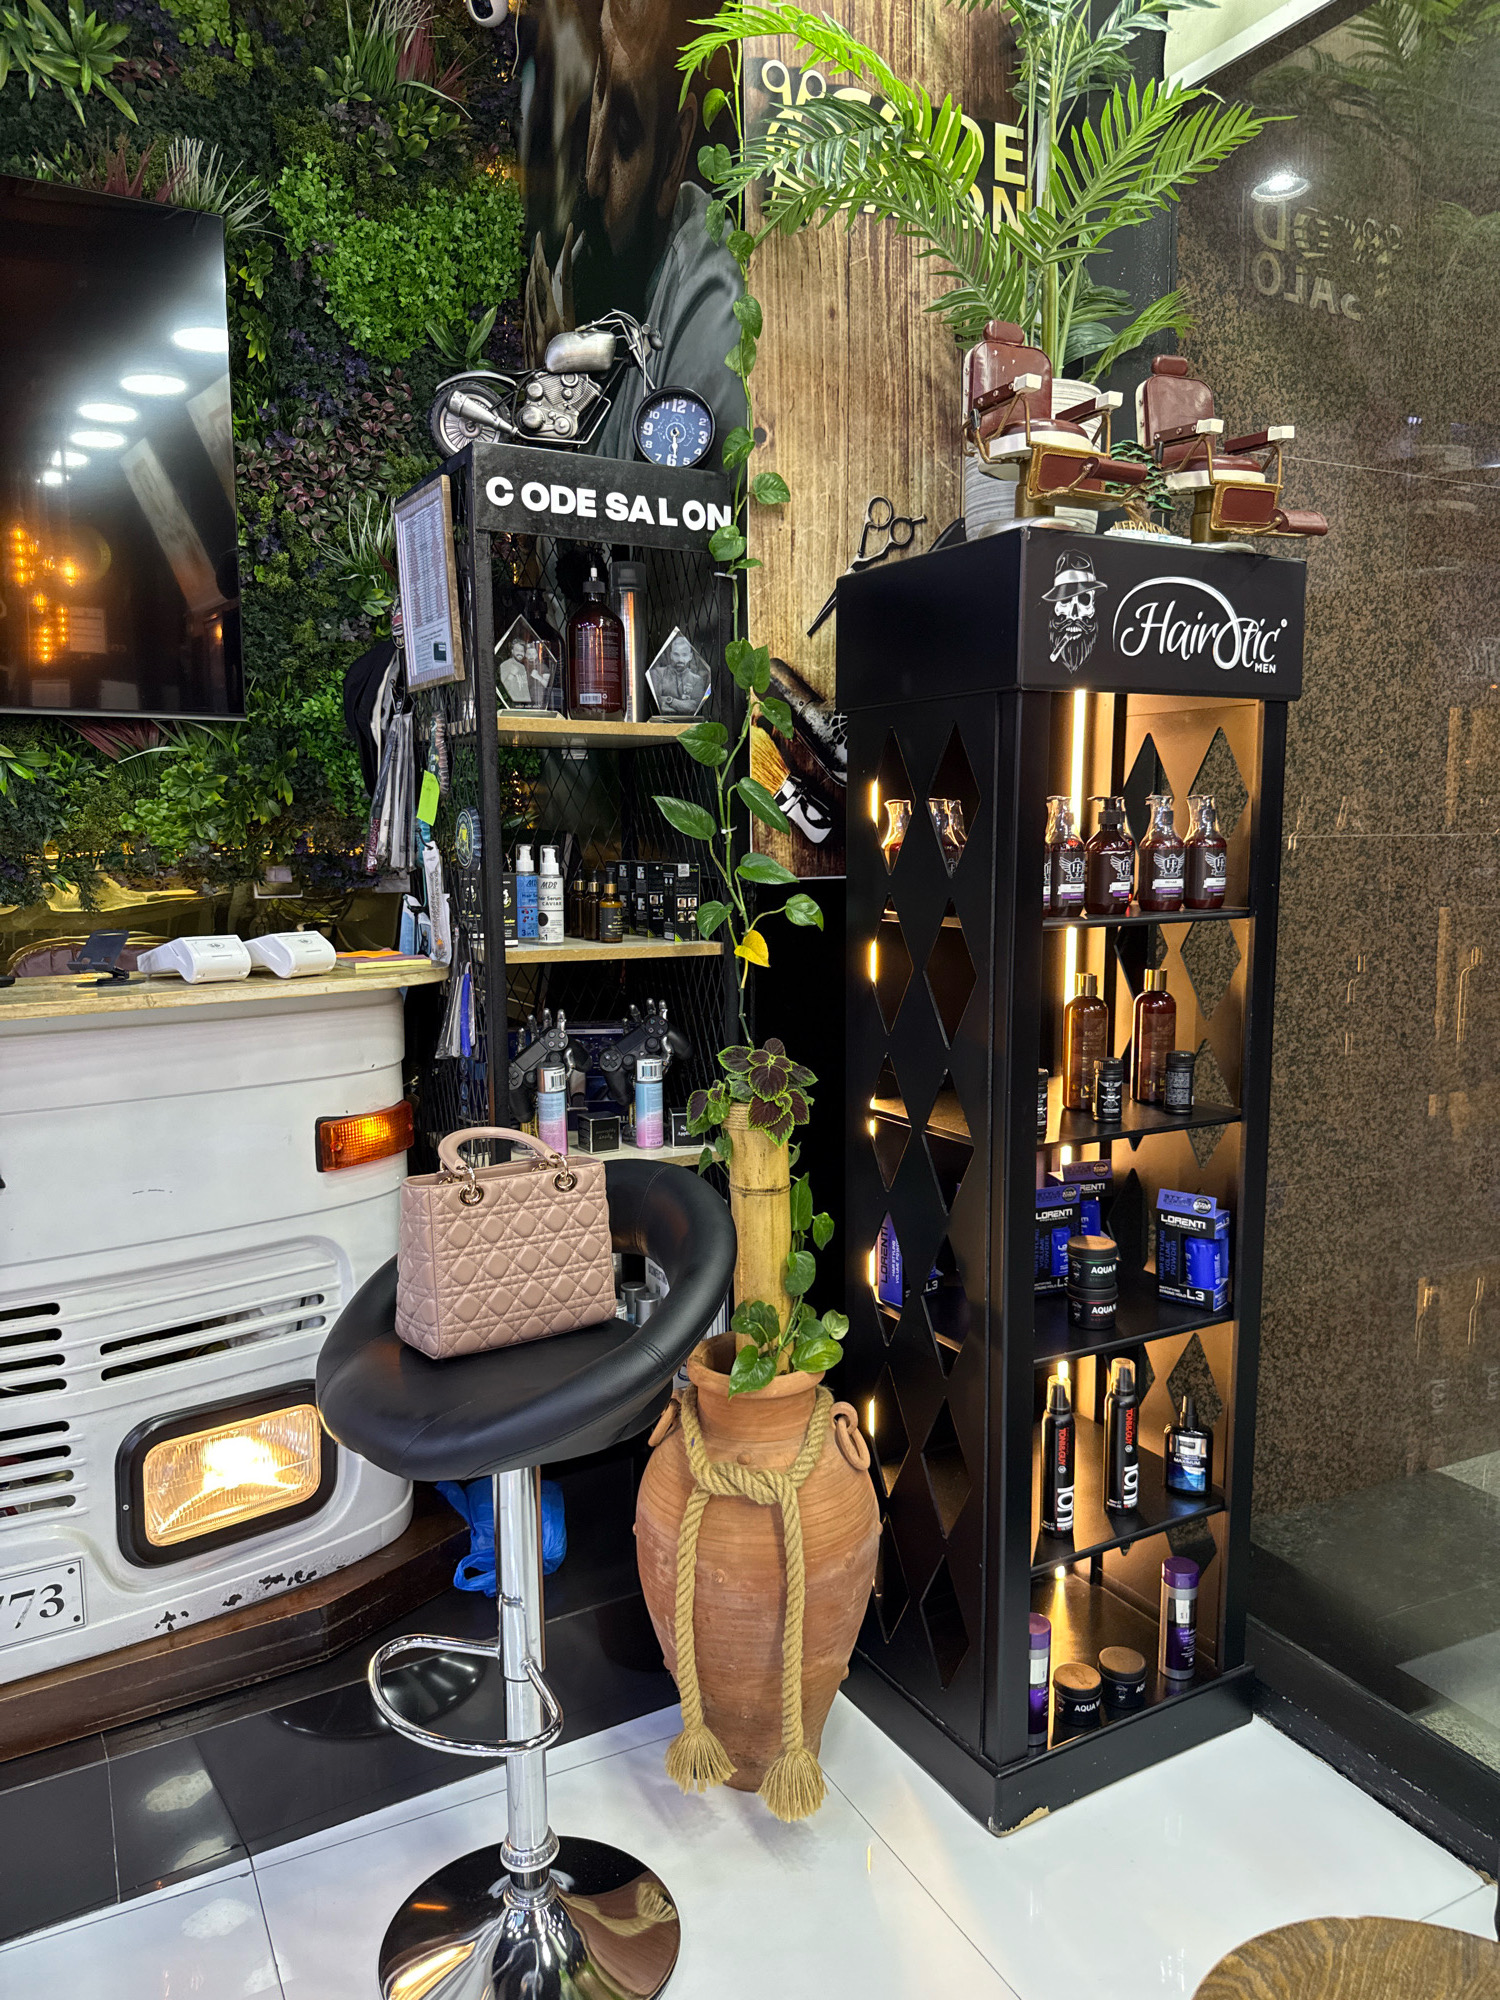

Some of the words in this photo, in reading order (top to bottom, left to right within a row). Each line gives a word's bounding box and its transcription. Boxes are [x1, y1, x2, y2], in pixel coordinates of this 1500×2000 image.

[671, 398, 688, 414] 12
[649, 410, 660, 420] 10
[698, 417, 707, 426] 2
[642, 421, 654, 436] 9
[698, 430, 709, 445] 3
[645, 440, 653, 449] 8
[654, 453, 663, 462] 7
[693, 447, 702, 456] 4
[666, 453, 677, 467] 6
[682, 457, 691, 466] 5
[485, 476, 597, 518] CODE
[605, 491, 732, 531] SALON
[1254, 663, 1276, 674] MEN
[1080, 1183, 1106, 1192] RENTI
[1035, 1208, 1073, 1220] LORENTI
[1160, 1213, 1206, 1230] LORENTI
[880, 1226, 888, 1284] LORENTI
[1091, 1265, 1113, 1275] AQUA
[925, 1280, 939, 1292] L3
[1186, 1288, 1205, 1301] L3
[1091, 1305, 1113, 1315] AQUA
[1125, 1408, 1134, 1445] TONI&GUY
[1058, 1427, 1067, 1465] TONI&GUY
[0, 1583, 65, 1629] 73
[1074, 1702, 1096, 1713] AQUA
